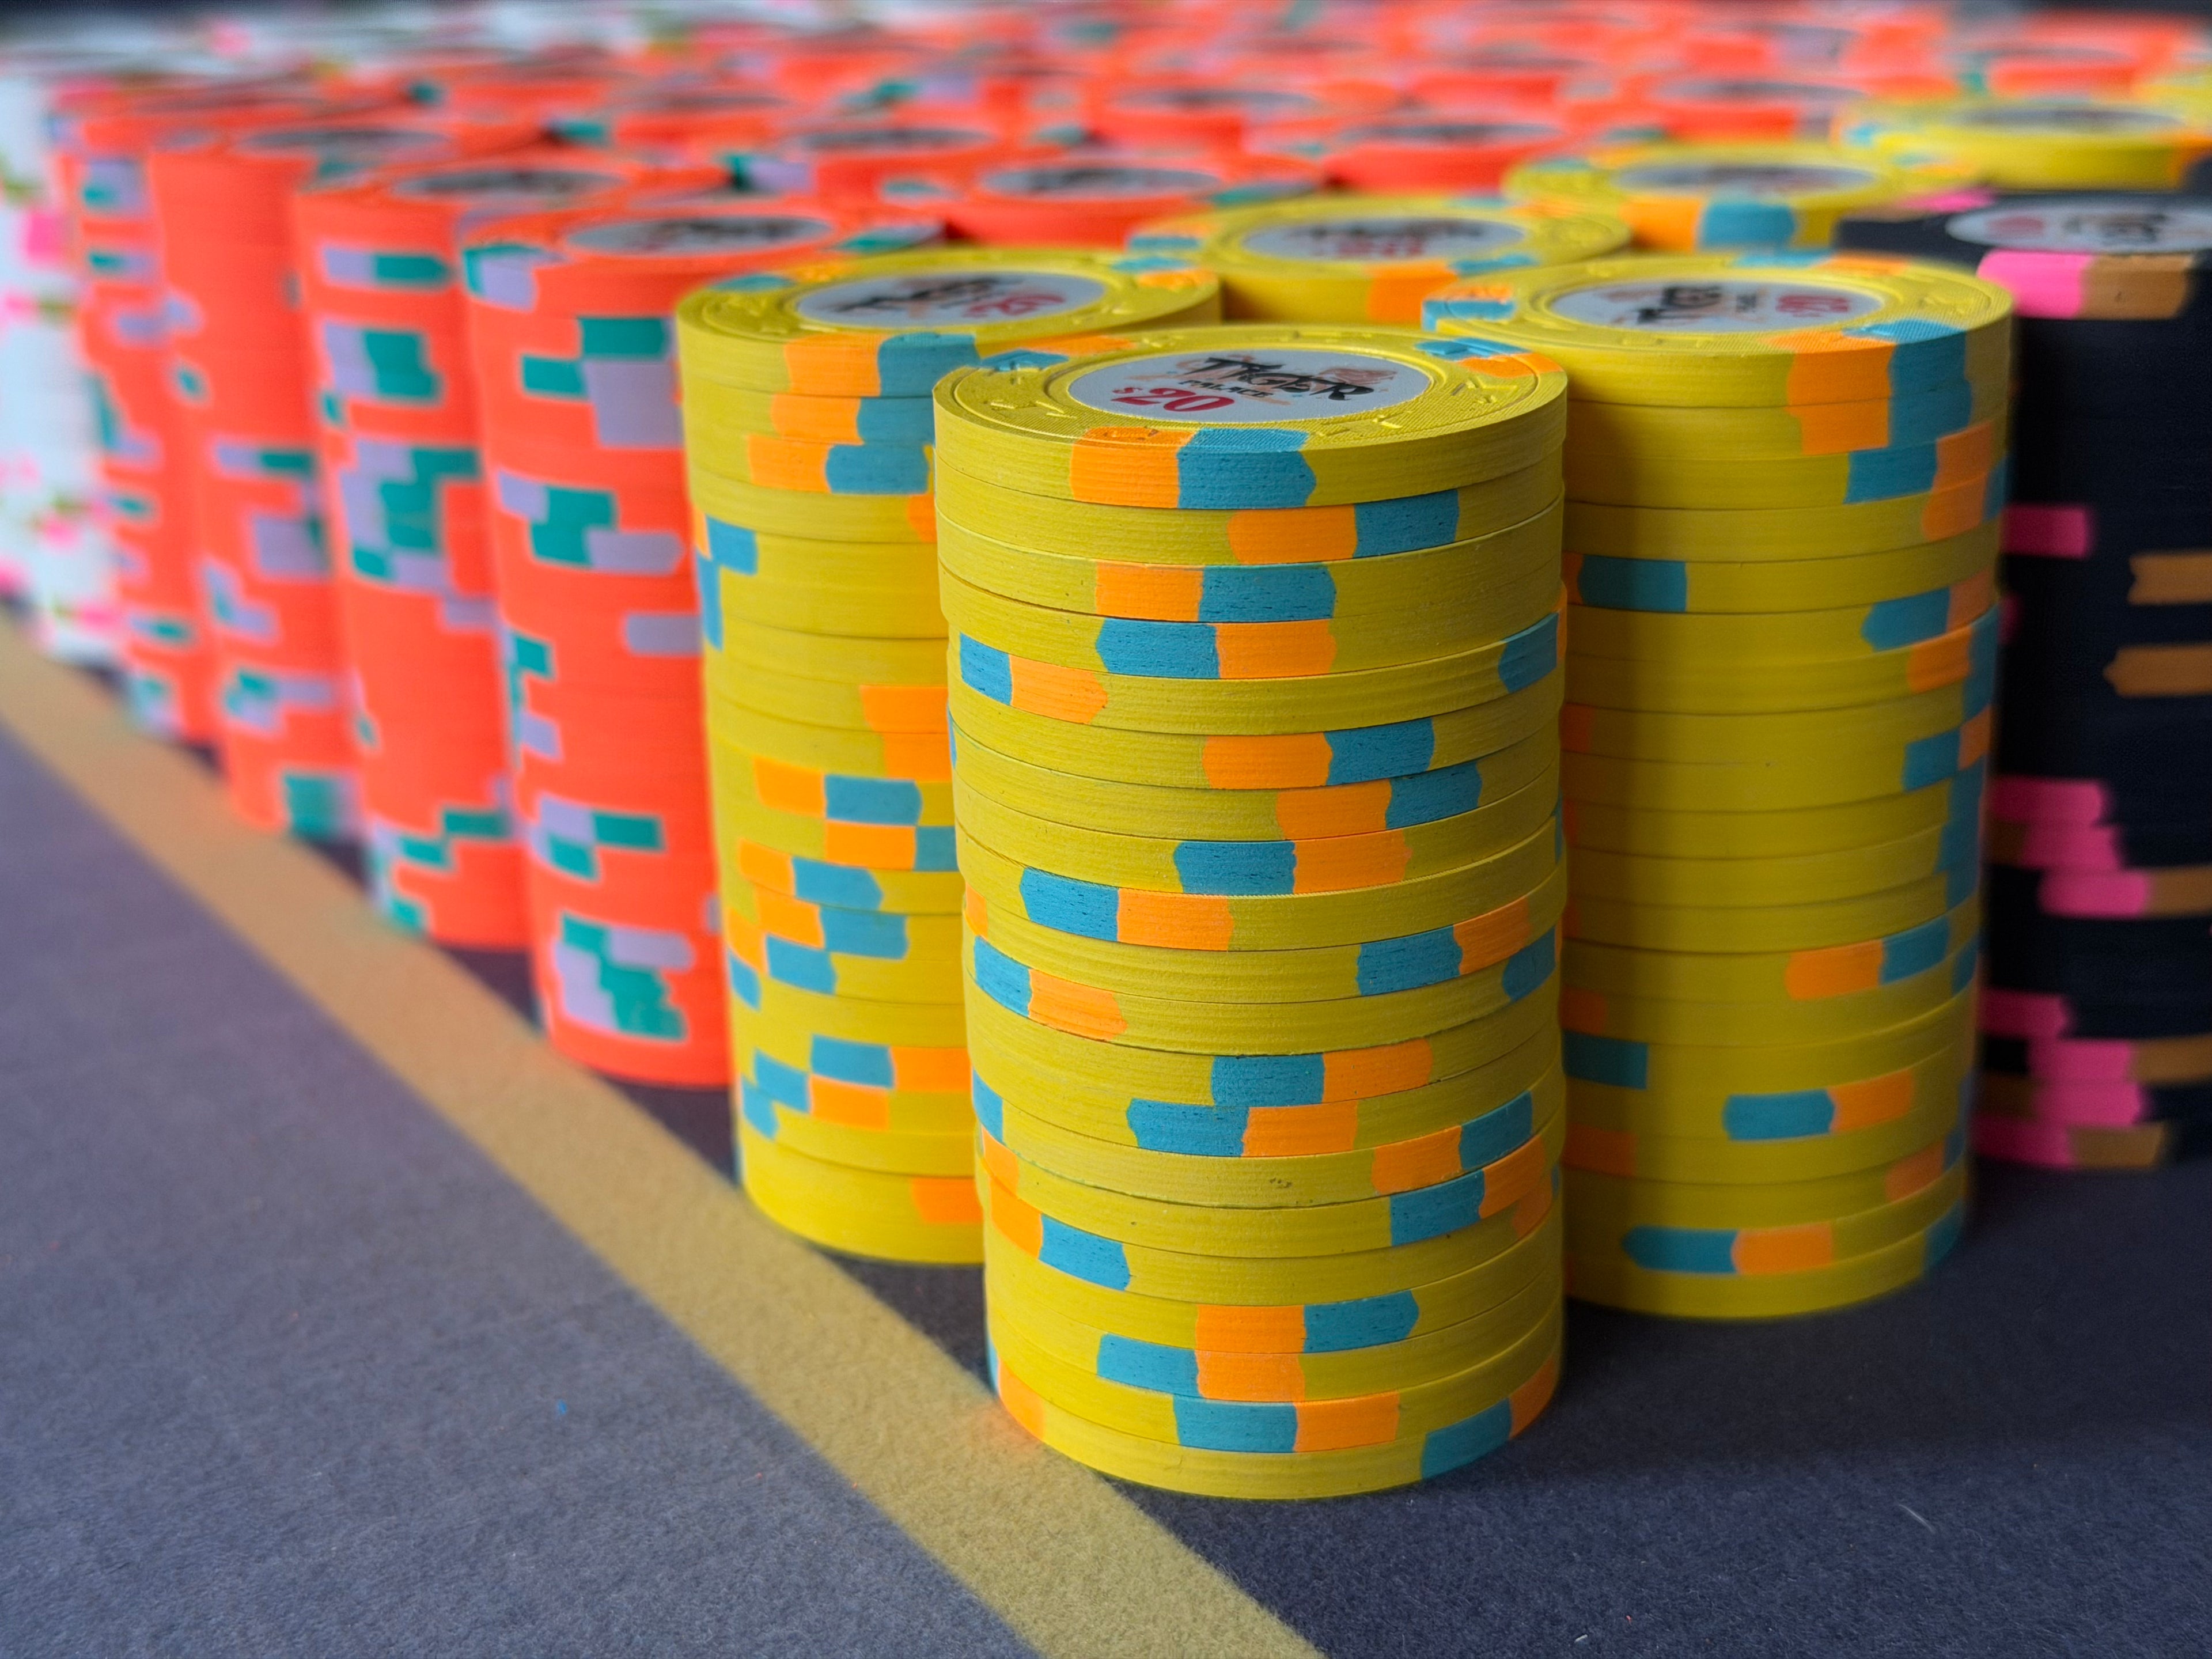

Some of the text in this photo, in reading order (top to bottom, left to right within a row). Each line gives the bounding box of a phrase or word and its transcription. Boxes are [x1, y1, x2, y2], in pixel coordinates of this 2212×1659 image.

[1177, 380, 1275, 398] PALACE
[1181, 357, 1374, 401] TIGER
[1111, 387, 1236, 412] $20
